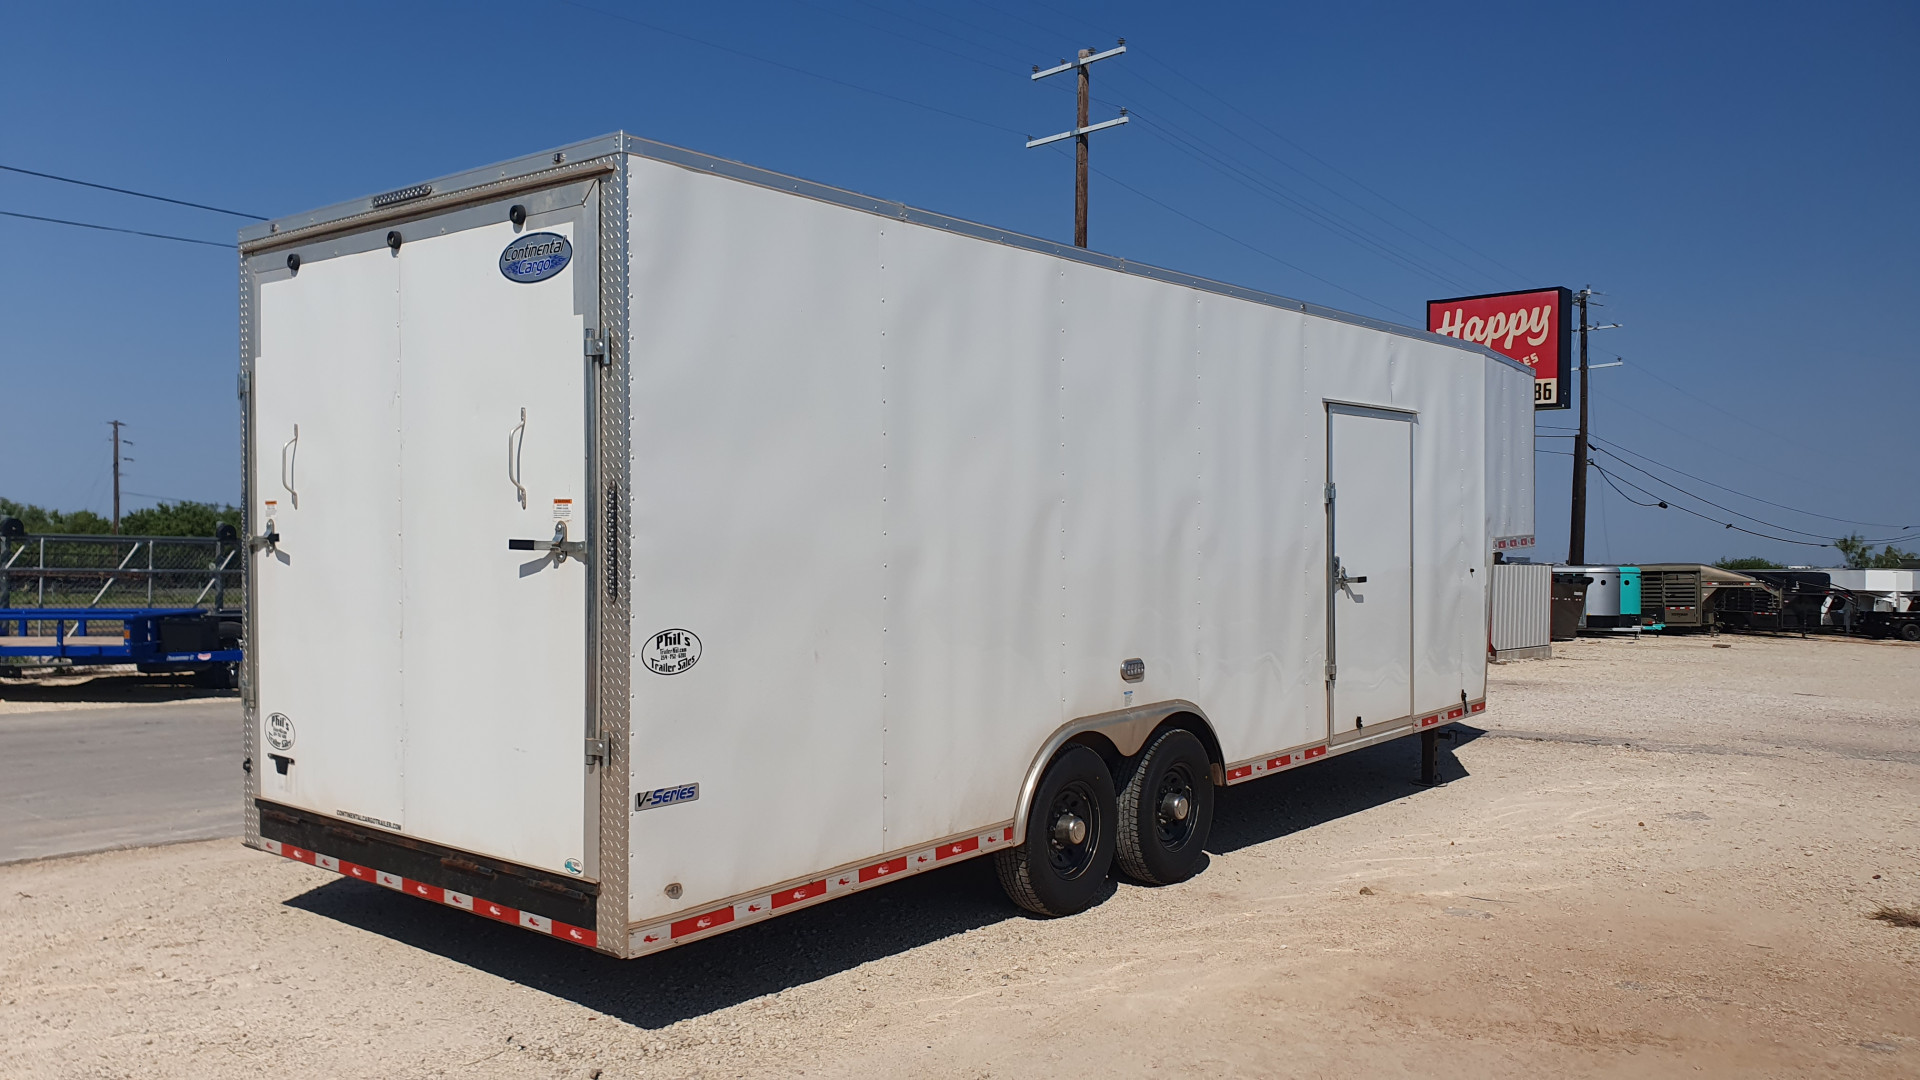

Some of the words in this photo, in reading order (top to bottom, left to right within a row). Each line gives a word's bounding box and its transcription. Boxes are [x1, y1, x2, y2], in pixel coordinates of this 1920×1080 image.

[504, 235, 567, 262] Continental
[518, 259, 552, 276] Cargo
[1436, 305, 1552, 350] Happy
[1518, 352, 1539, 366] ES
[656, 631, 691, 651] Phil's
[650, 657, 677, 673] Trailer
[677, 655, 695, 671] Sales
[637, 784, 697, 808] V-Series
